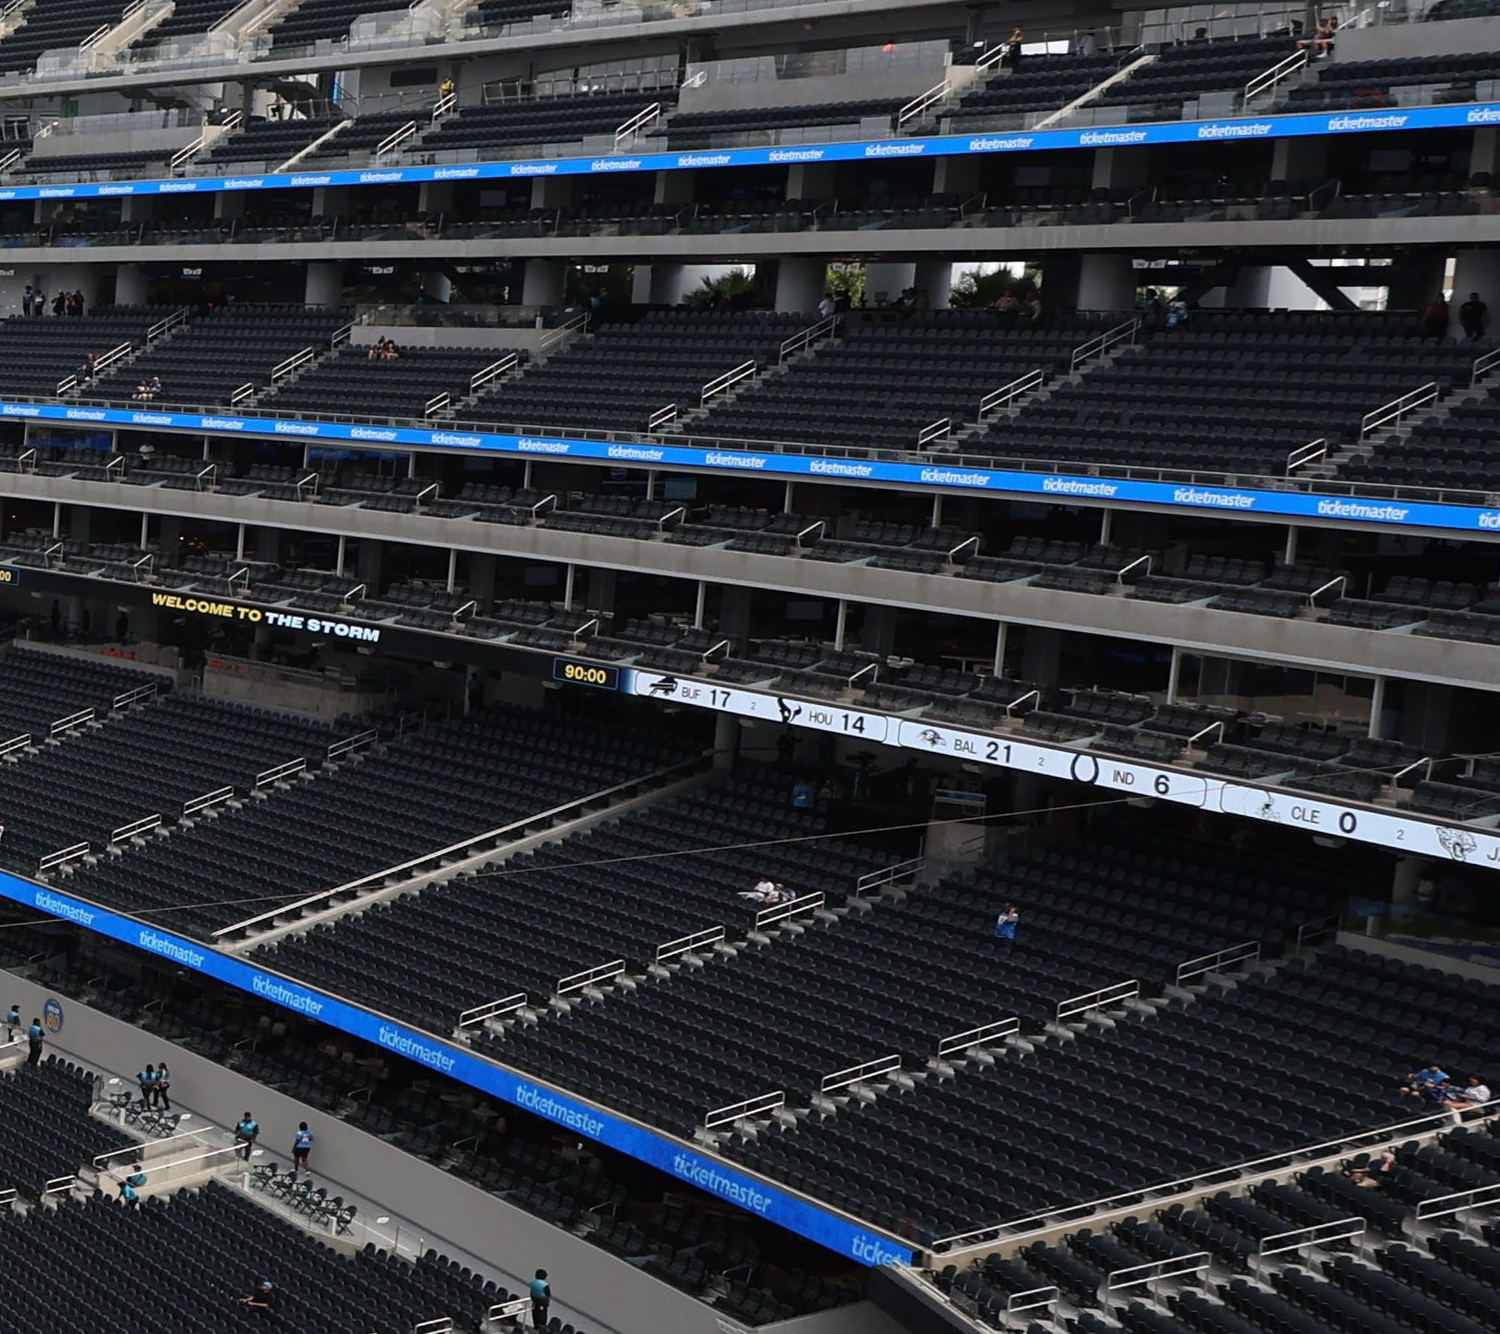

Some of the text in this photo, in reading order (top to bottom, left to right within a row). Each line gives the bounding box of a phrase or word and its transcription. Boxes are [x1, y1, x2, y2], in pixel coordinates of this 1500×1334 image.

[1327, 115, 1409, 131] ticketmaster
[768, 149, 825, 162] ticketmaster
[517, 438, 571, 453] ticketmaster
[919, 468, 991, 486] ticketmaster
[1173, 488, 1257, 508] ticketmaster
[152, 592, 380, 643] WELCOME TO THE STORM
[564, 664, 607, 685] 90:00
[680, 686, 732, 708] BUF 17
[750, 701, 756, 710] 2
[808, 709, 865, 734] HOU 14
[953, 738, 1013, 764] BAL 21
[1037, 756, 1045, 767] 2
[1112, 768, 1169, 796] IND 6
[1291, 805, 1357, 834] CLE 0
[1396, 829, 1404, 841] 2
[251, 973, 324, 1018] ticketmaster
[515, 1084, 604, 1137] ticketmaster
[672, 1151, 772, 1215] ticketmaster
